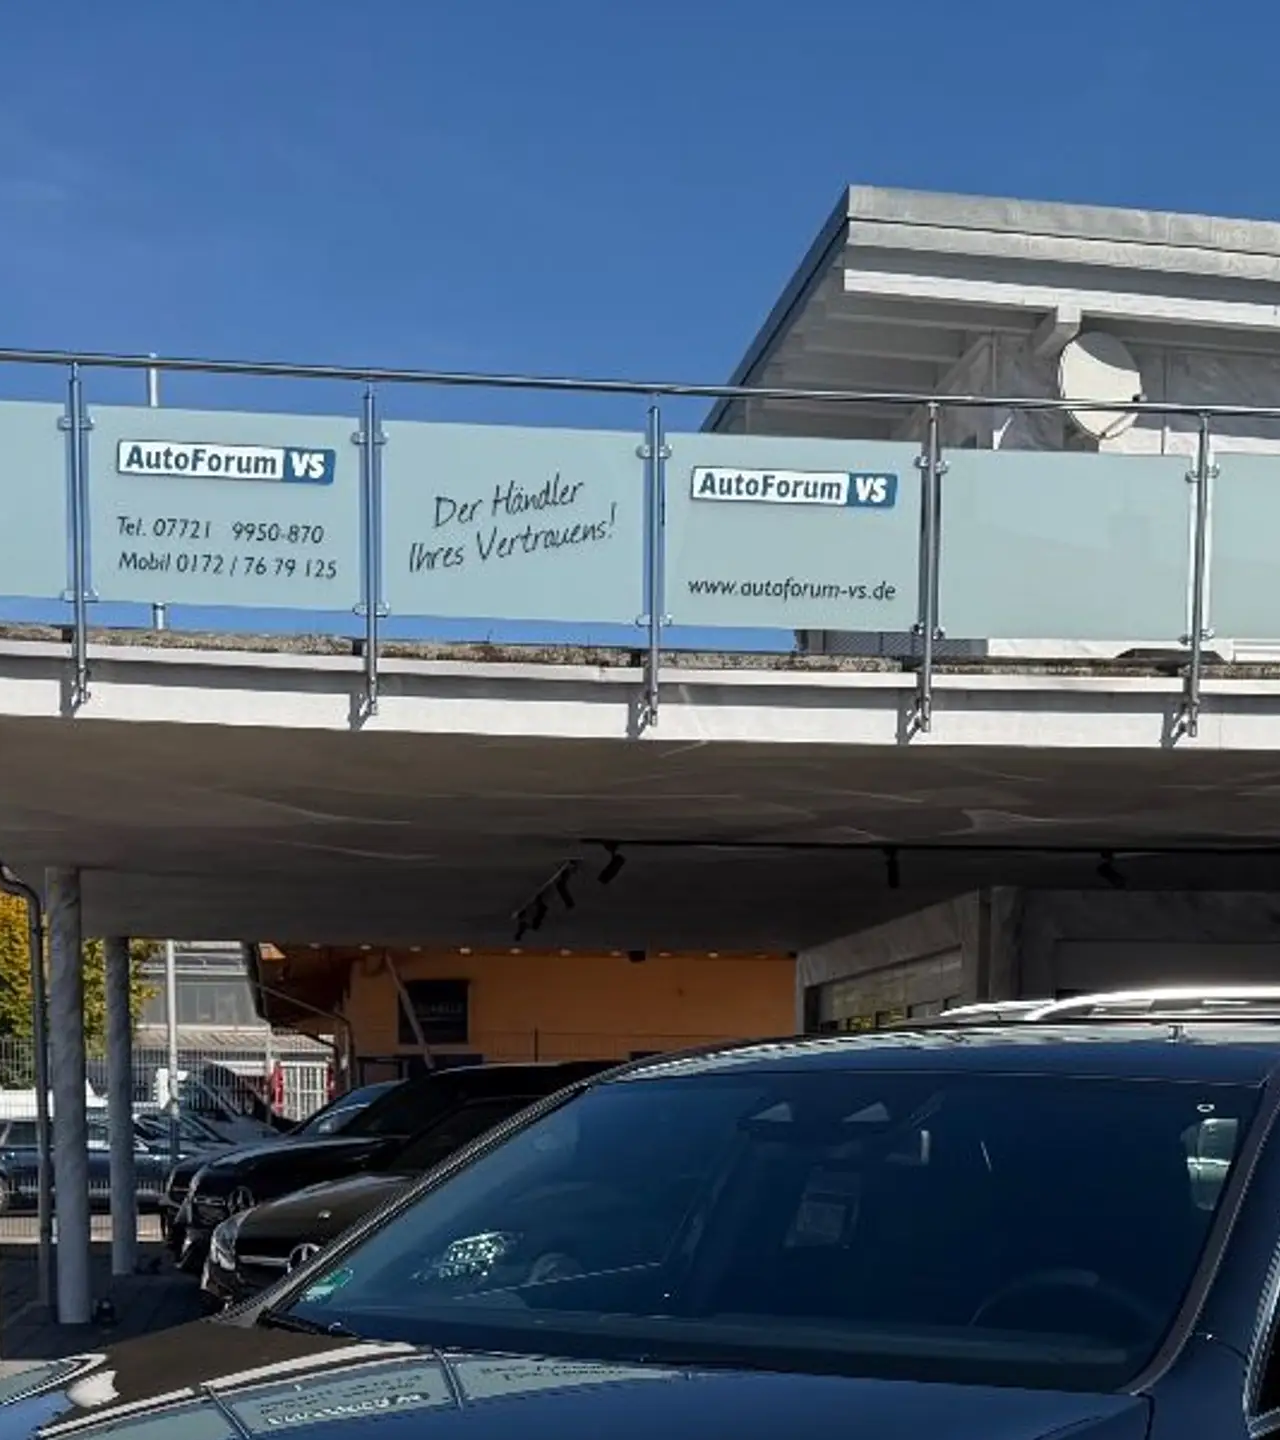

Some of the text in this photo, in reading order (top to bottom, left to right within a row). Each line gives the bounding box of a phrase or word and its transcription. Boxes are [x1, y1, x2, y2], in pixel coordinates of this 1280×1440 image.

[126, 445, 325, 479] AutoForum VS
[434, 472, 584, 528] Der Händler
[698, 472, 888, 503] AutoForum VS
[117, 515, 325, 544] Tel. 07721 9950-870
[409, 501, 618, 573] Ihres Vertrauens!
[119, 552, 169, 573] Mobil
[687, 576, 897, 602] www.autoforum-vs.de
